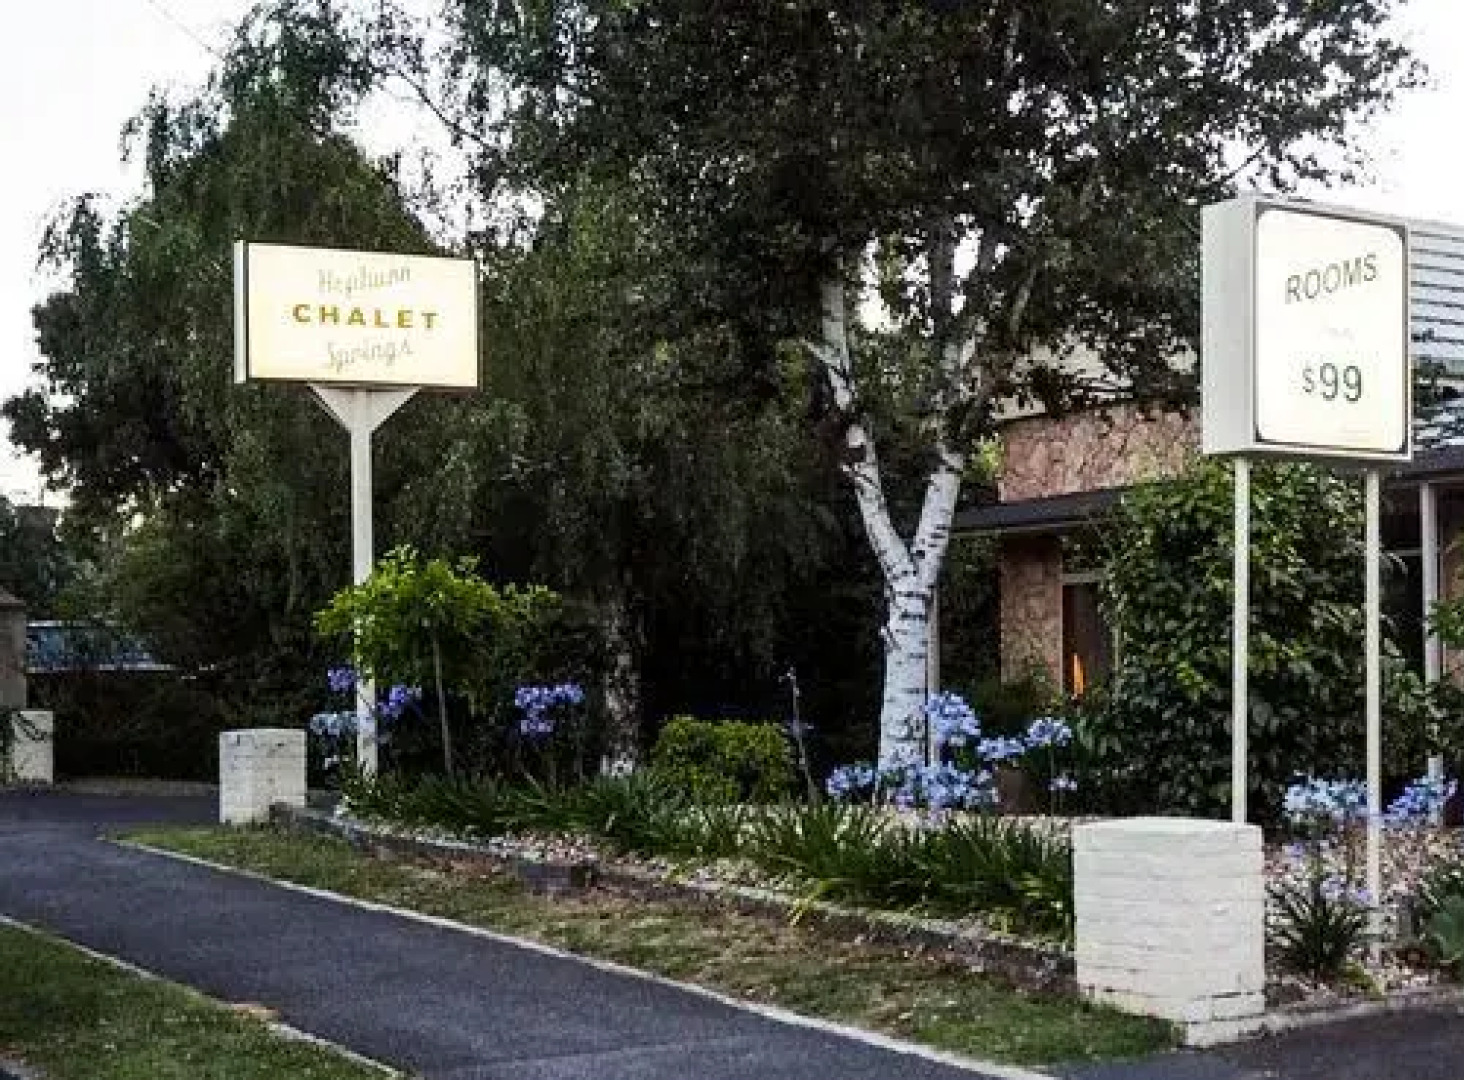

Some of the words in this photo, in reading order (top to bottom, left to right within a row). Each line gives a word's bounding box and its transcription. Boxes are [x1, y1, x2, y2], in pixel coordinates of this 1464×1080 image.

[318, 265, 411, 299] Hepburn
[1285, 252, 1376, 304] ROOMS
[292, 303, 438, 329] CHALET
[323, 338, 413, 373] Springs
[1302, 362, 1362, 403] $99
